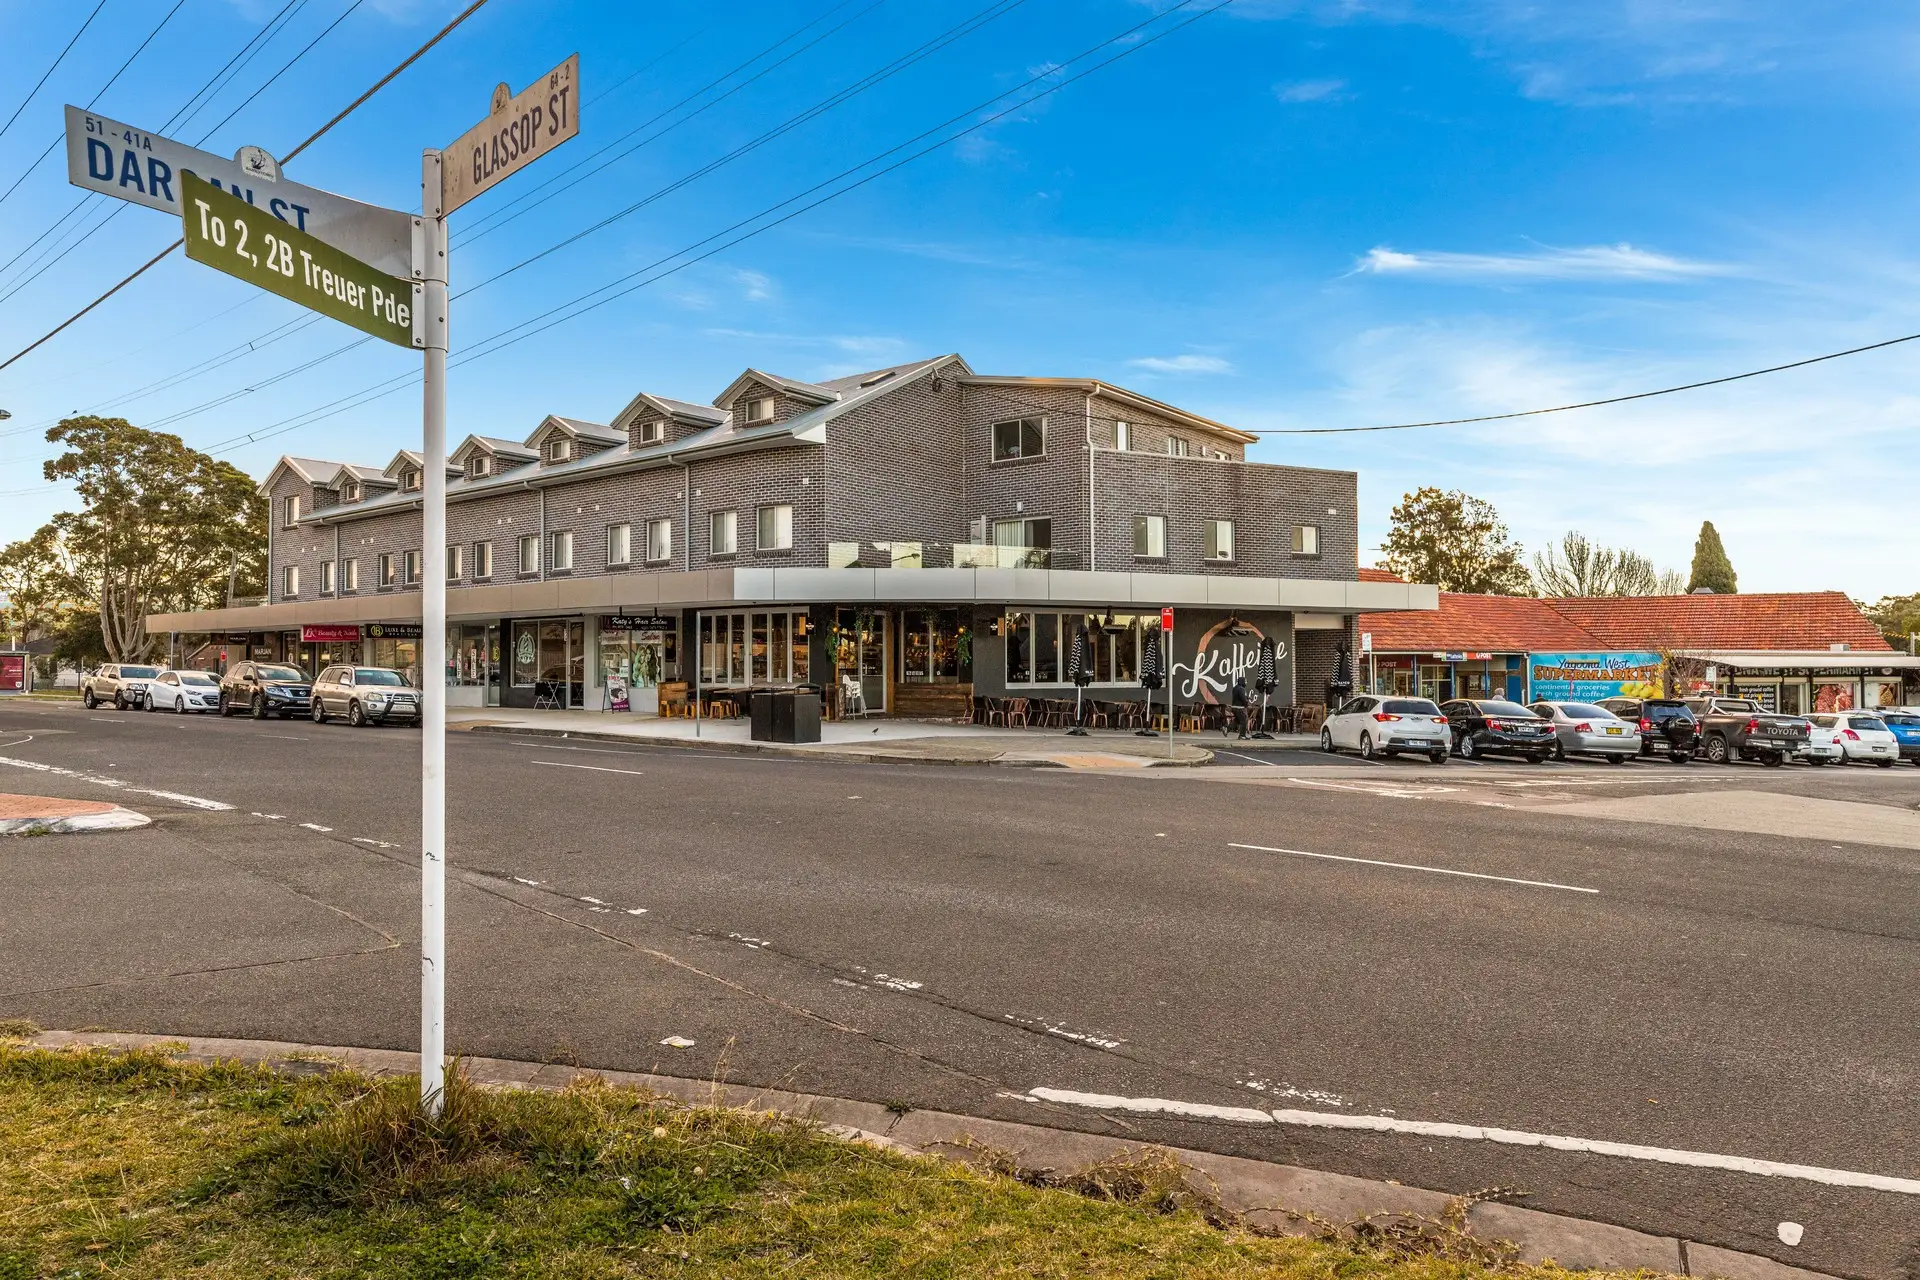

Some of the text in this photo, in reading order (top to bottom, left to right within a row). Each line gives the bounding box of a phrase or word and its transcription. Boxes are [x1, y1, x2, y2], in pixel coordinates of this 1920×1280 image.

[550, 72, 559, 90] 64
[565, 64, 570, 80] 2
[85, 116, 103, 136] 51
[123, 130, 153, 152] 41A
[473, 85, 570, 185] GLASSOP ST
[86, 137, 311, 233] DAR ST
[194, 198, 411, 329] To 2, 2B Treuer Pde
[612, 616, 668, 626] Katy's Hair Salon
[1480, 652, 1492, 660] POST
[1557, 658, 1630, 670] Yagoona West
[1172, 641, 1288, 698] Kaffeie
[1534, 664, 1658, 681] SUPERMARKET
[1576, 684, 1611, 692] groceries
[1766, 727, 1799, 736] TOYOTA
